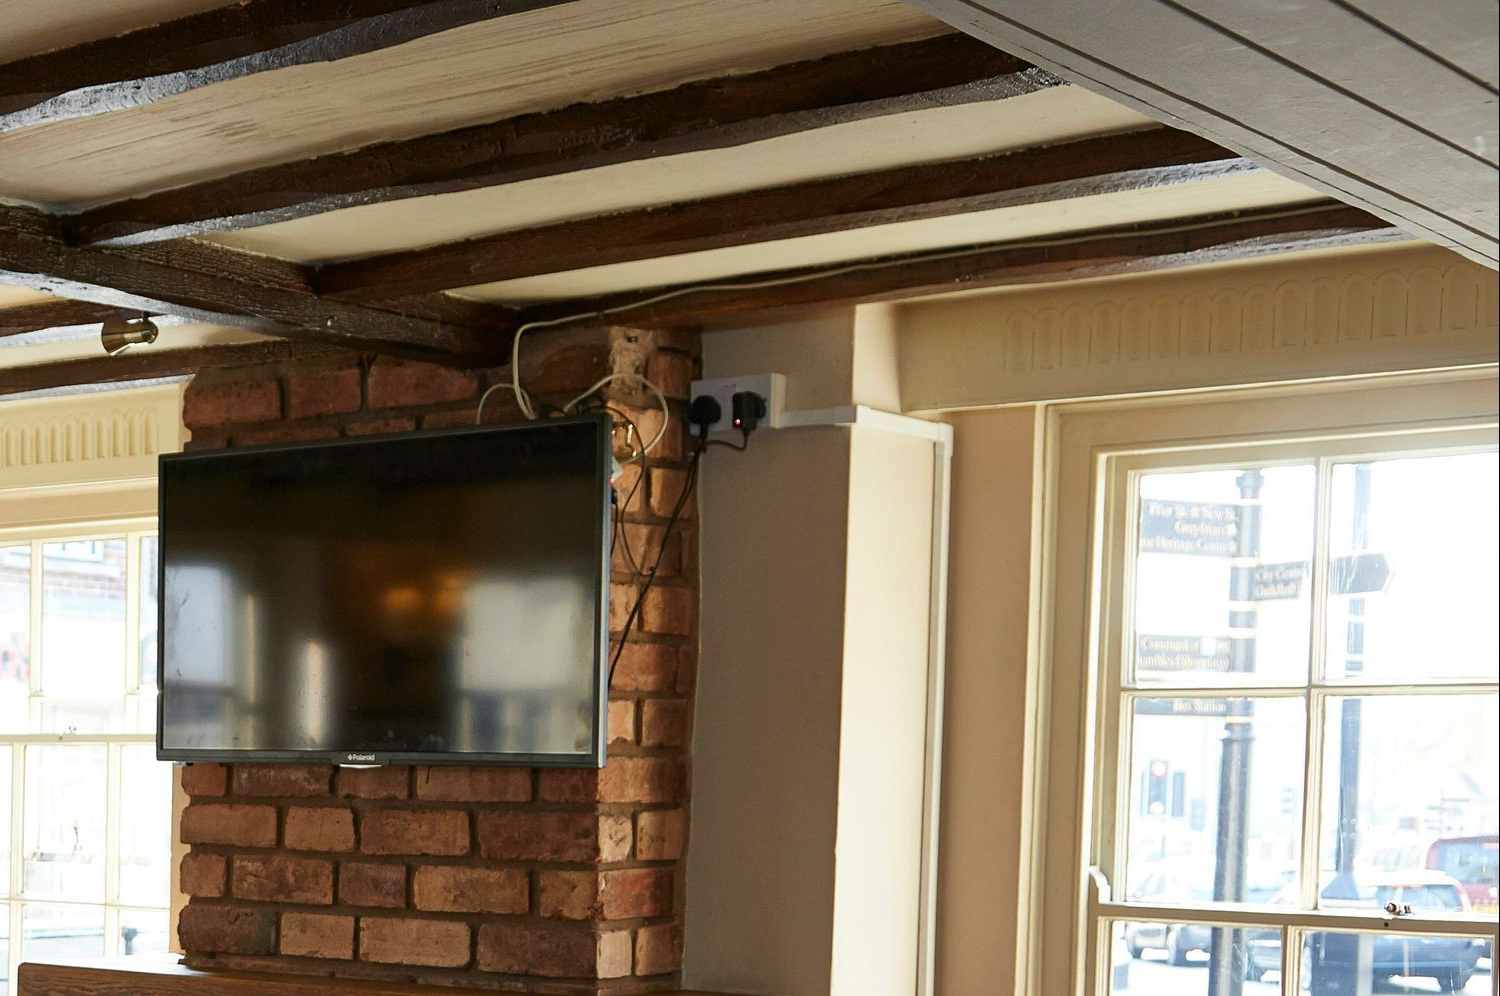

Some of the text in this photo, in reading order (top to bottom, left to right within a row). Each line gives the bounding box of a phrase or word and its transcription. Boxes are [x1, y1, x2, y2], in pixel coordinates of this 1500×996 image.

[1202, 506, 1224, 521] New
[1194, 698, 1227, 713] Station
[353, 753, 376, 761] Polaroid
